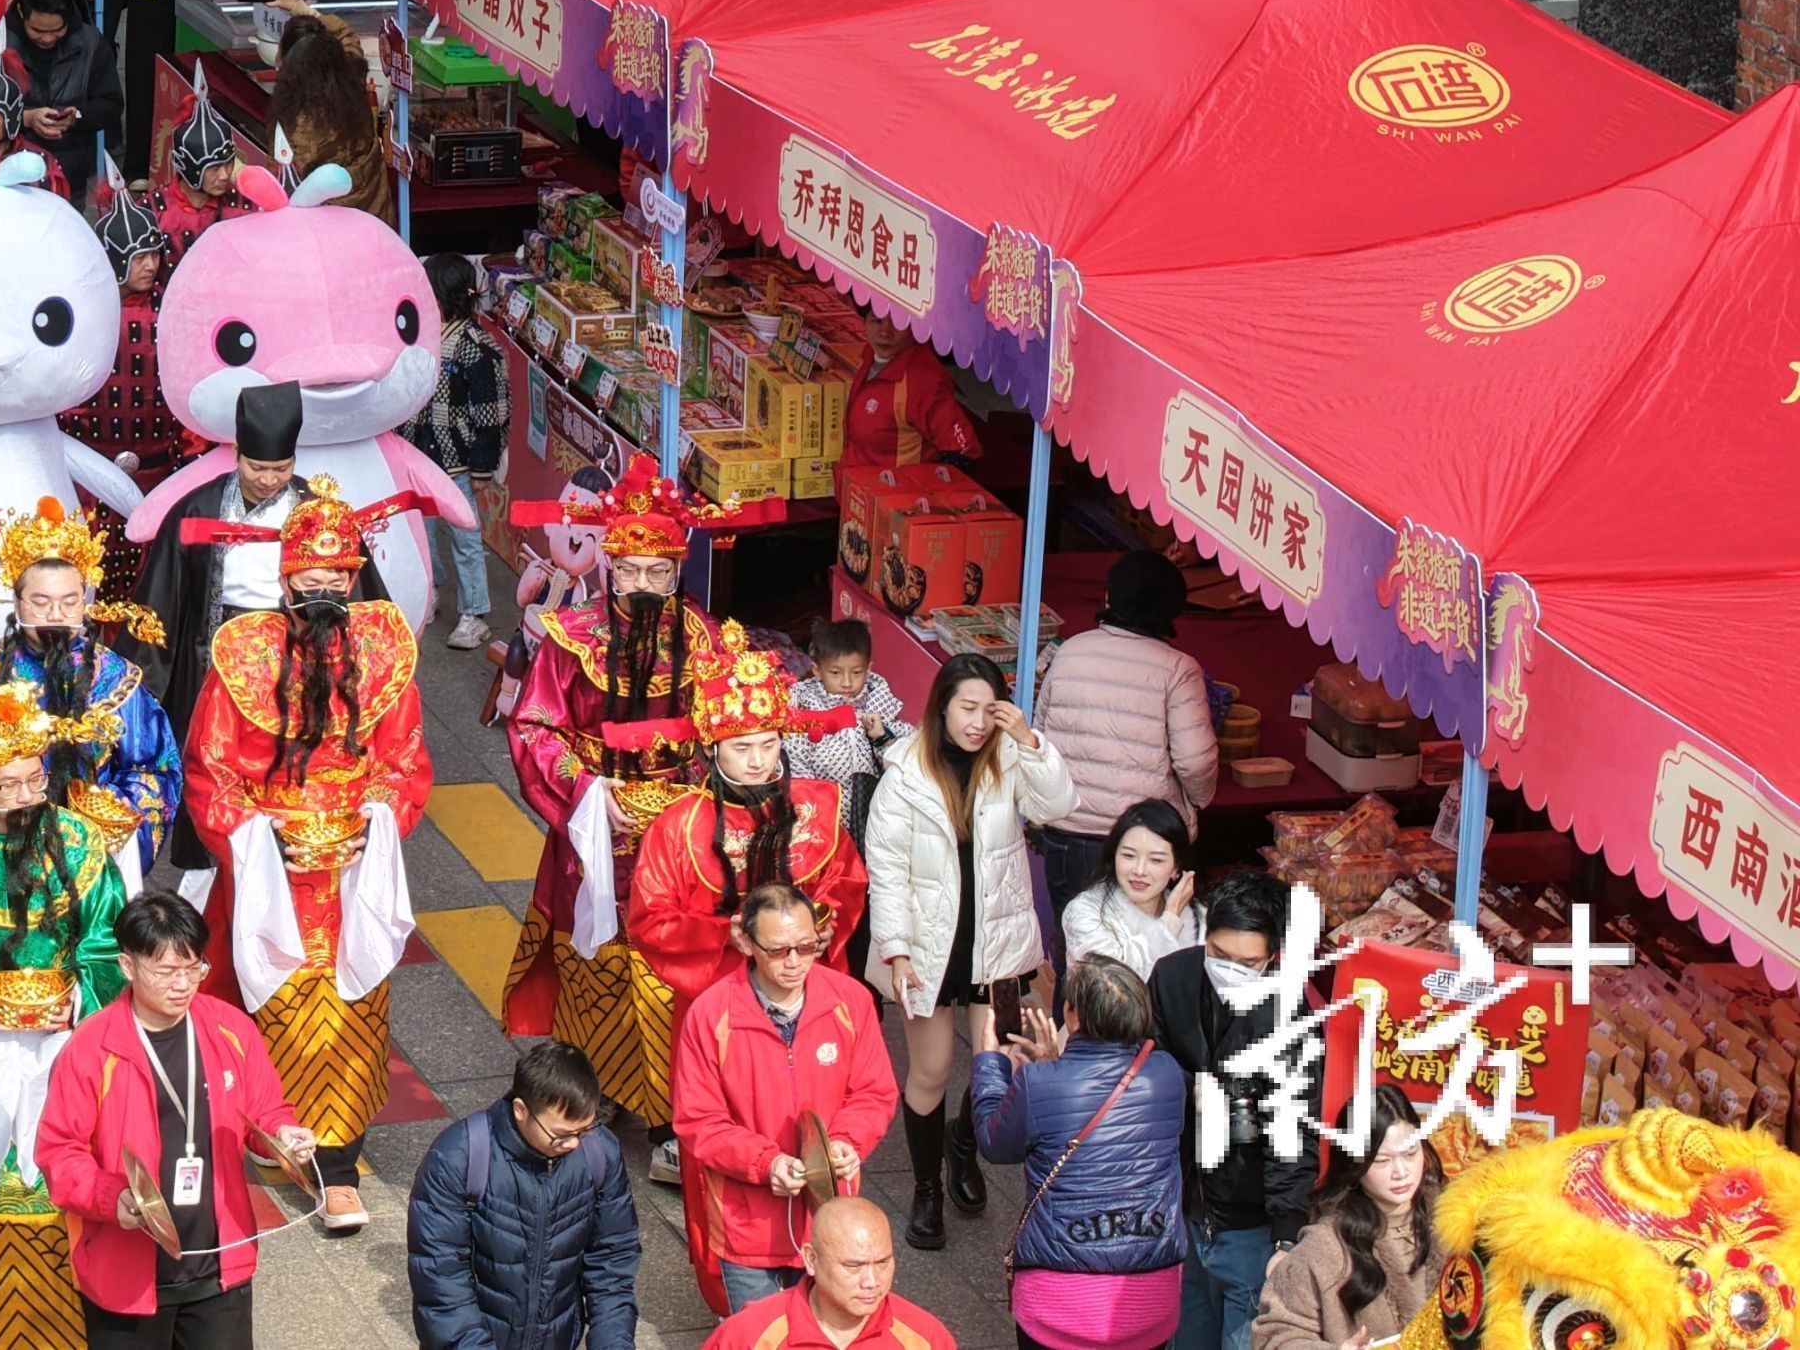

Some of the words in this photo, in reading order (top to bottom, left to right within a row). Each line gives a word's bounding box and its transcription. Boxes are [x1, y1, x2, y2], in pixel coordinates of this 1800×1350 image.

[613, 45, 664, 99] 非遗年货
[1376, 123, 1415, 141] SHI
[1434, 128, 1483, 143] WAN
[1493, 112, 1524, 134] PAI
[985, 232, 1037, 286] 朱紫墟市
[987, 275, 1046, 340] 非遗年货
[1464, 335, 1501, 347] PAI
[1179, 426, 1310, 571] 天园饼家
[1396, 527, 1462, 593] 朱紫墟市
[1398, 582, 1478, 663] 非遗年货
[1066, 1209, 1166, 1243] GIRLS
